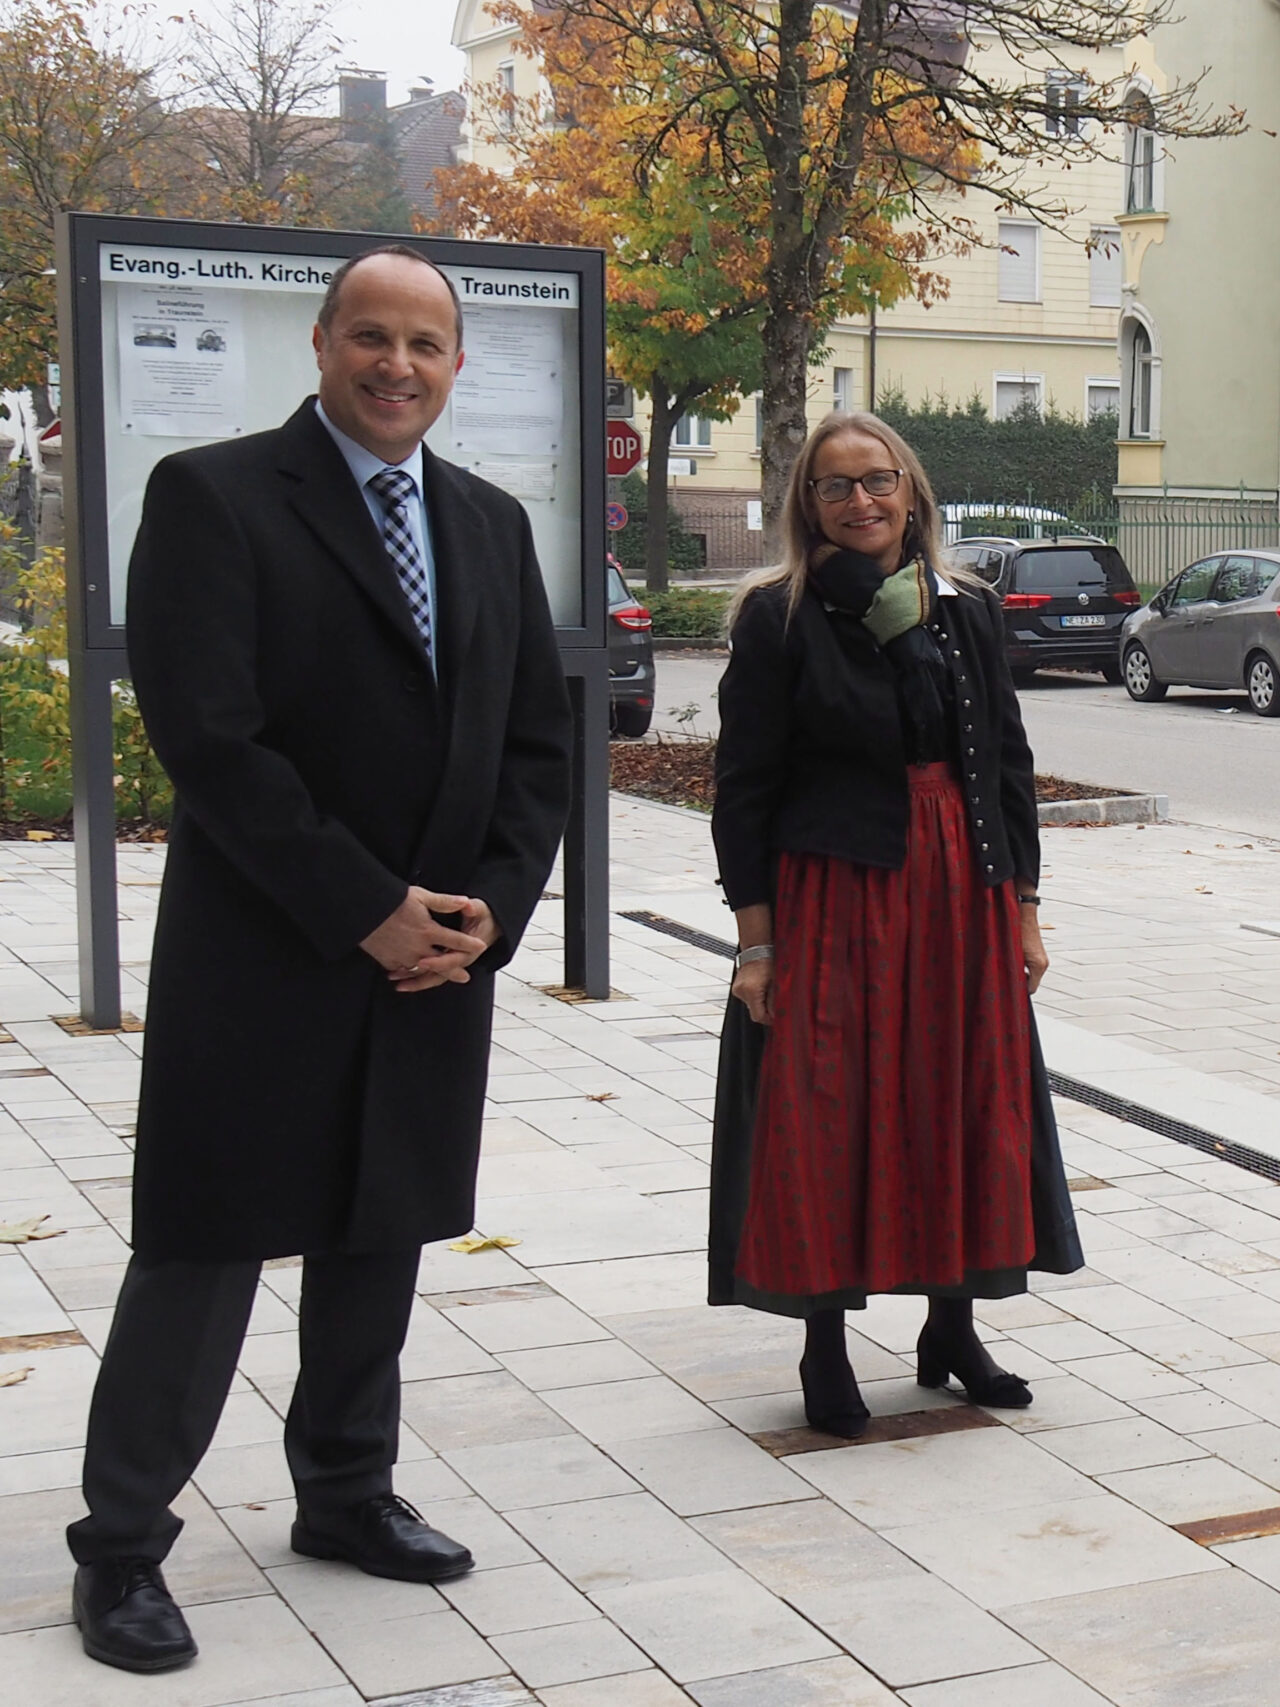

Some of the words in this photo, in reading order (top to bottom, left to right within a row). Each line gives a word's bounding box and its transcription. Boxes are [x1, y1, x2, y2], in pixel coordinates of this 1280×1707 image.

[109, 253, 254, 280] Evang.-Luth.
[461, 276, 570, 300] Traunstein
[606, 436, 638, 459] TOP
